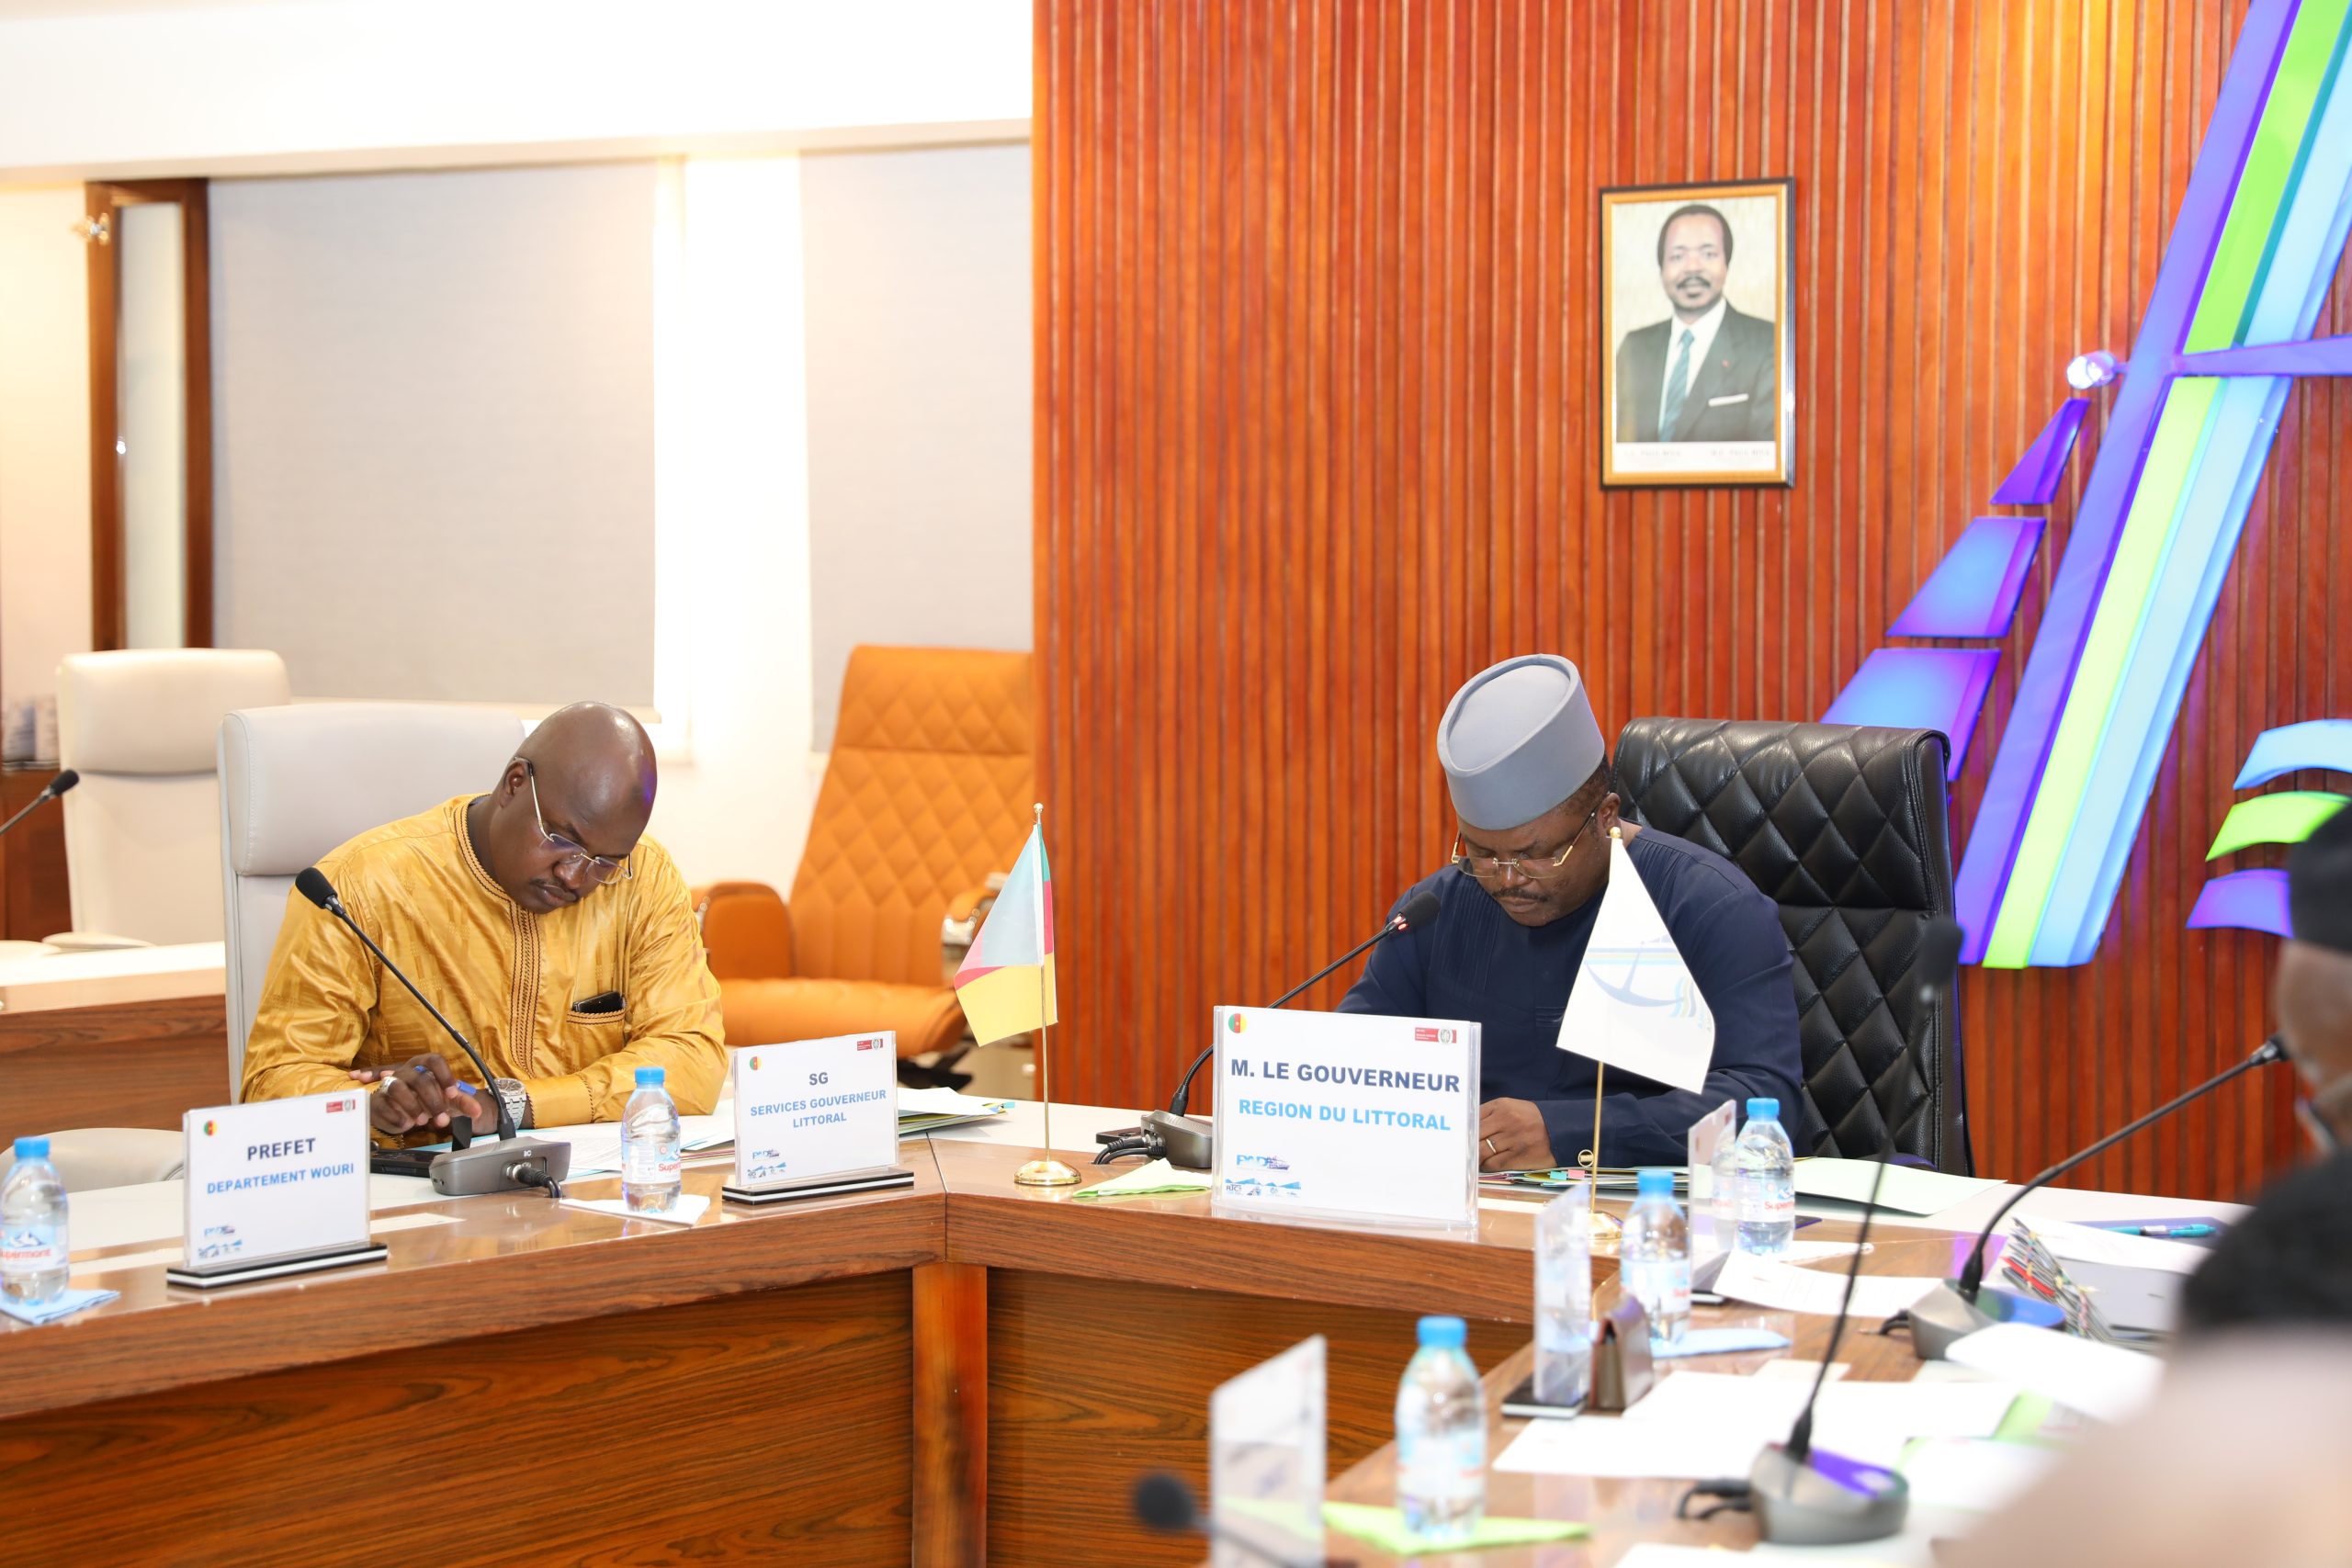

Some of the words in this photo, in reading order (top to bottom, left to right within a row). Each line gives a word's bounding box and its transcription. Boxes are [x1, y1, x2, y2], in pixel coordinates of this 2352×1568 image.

[808, 1072, 829, 1086] SG
[1231, 1059, 1255, 1077] M.
[1263, 1061, 1289, 1080] LE
[1297, 1064, 1460, 1093] GOUVERNEUR
[750, 1100, 807, 1117] SERVICES
[809, 1089, 887, 1109] GOUVERNEUR
[1238, 1099, 1312, 1120] REGION
[1319, 1105, 1346, 1122] DU
[1353, 1108, 1451, 1131] LITTORAL
[793, 1112, 847, 1129] LITTORAL
[247, 1137, 316, 1161] PREFET
[207, 1169, 307, 1194] DEPARTEMENT
[311, 1163, 355, 1179] WOURI
